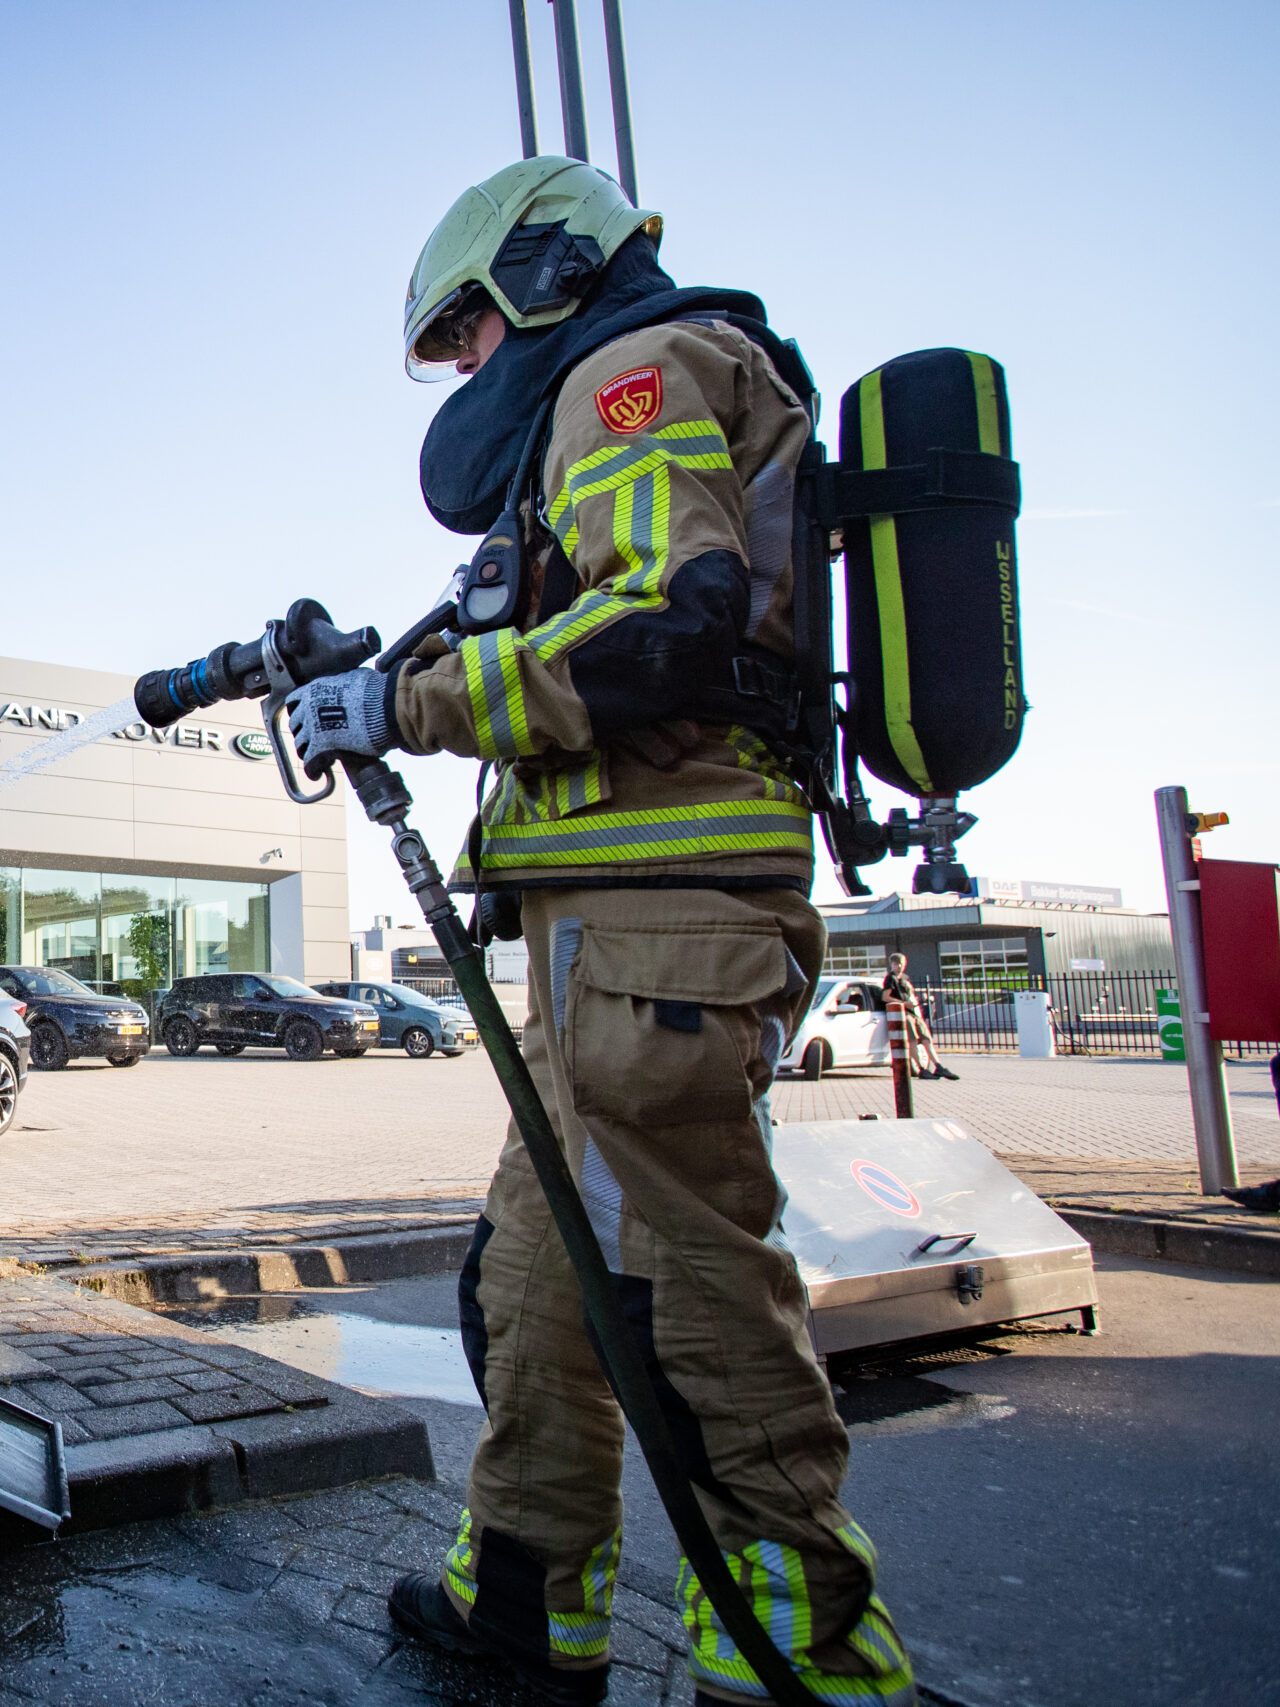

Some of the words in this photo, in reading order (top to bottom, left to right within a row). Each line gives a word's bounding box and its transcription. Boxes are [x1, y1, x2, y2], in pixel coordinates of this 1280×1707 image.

[602, 371, 653, 397] BRANDWEER
[111, 722, 224, 751] OVER
[992, 880, 1017, 891] DAF
